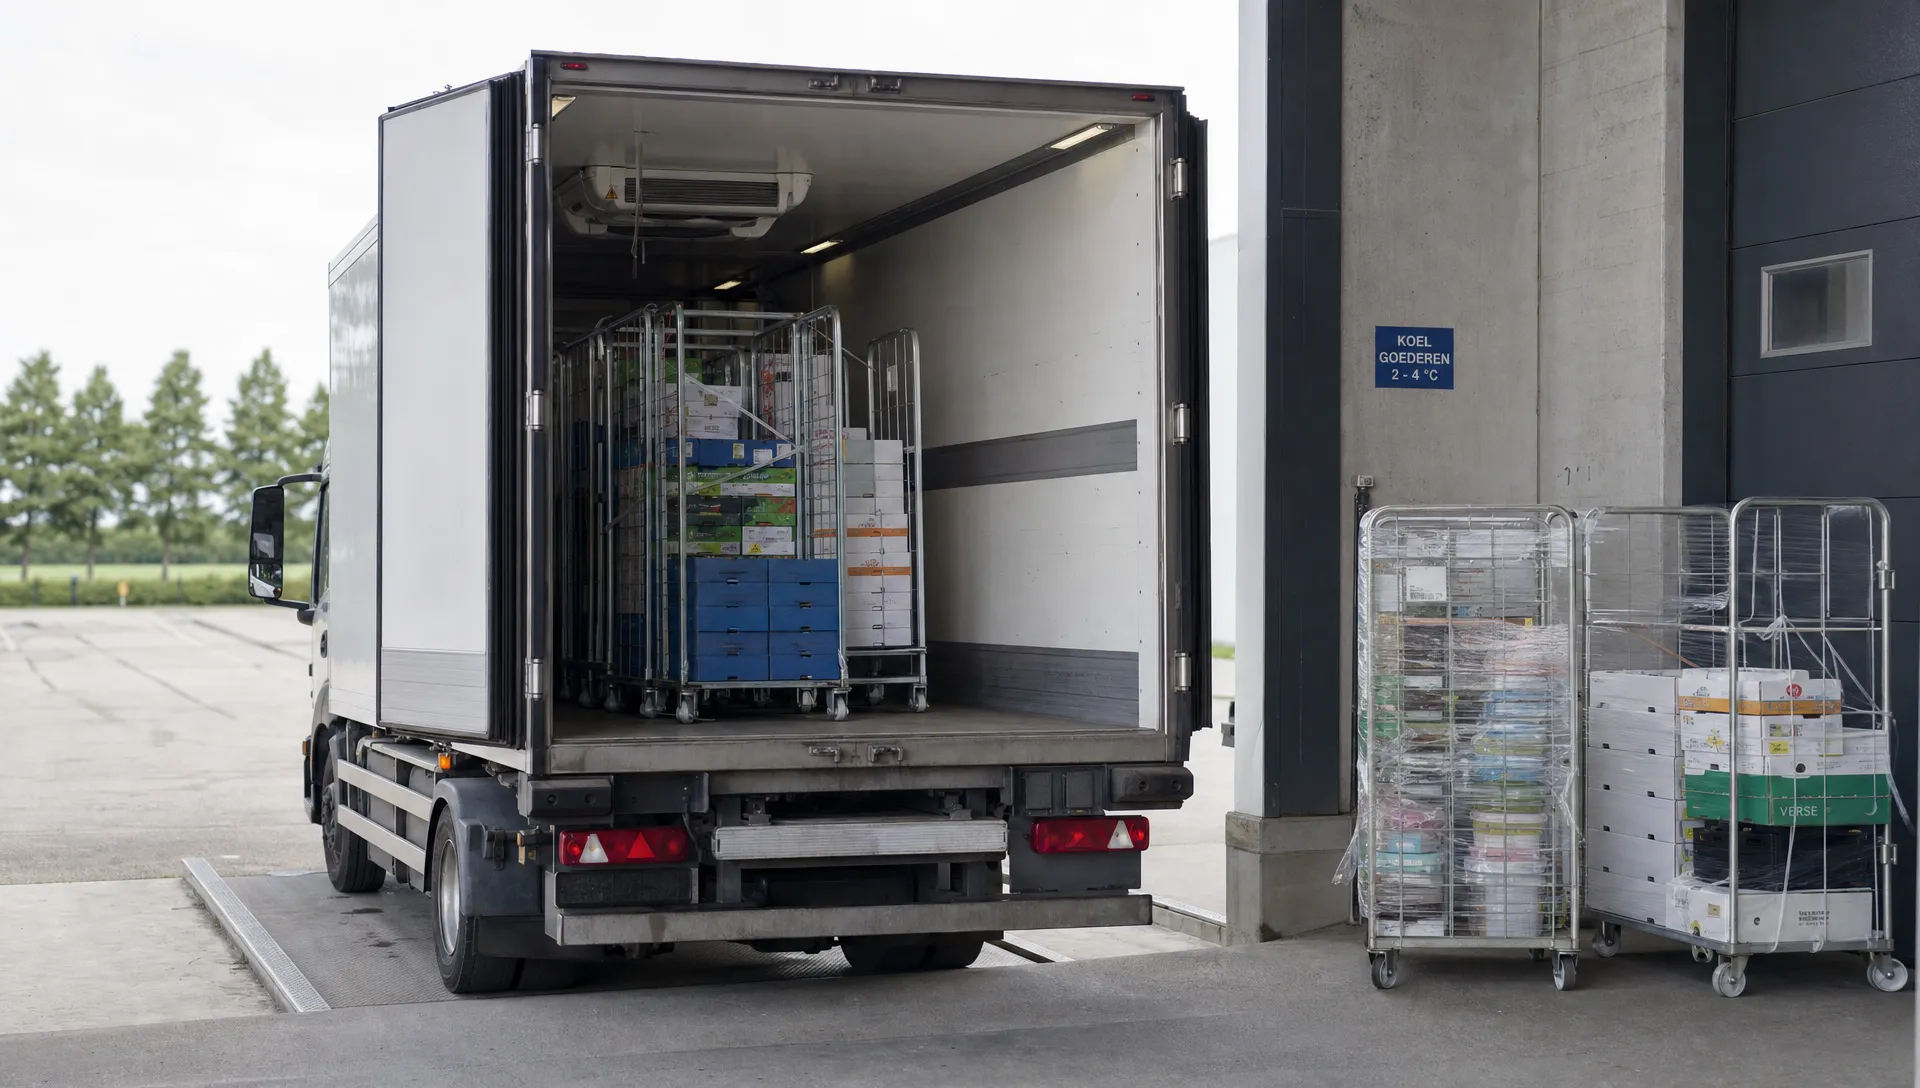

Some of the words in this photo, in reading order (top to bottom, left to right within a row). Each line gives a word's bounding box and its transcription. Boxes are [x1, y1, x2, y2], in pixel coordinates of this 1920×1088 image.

[1397, 335, 1432, 347] KOEL
[1379, 352, 1450, 364] GOEDEREN
[1392, 369, 1399, 380] 2
[1411, 369, 1420, 380] 4
[1423, 369, 1438, 381] °C
[1780, 805, 1818, 817] VERSE
